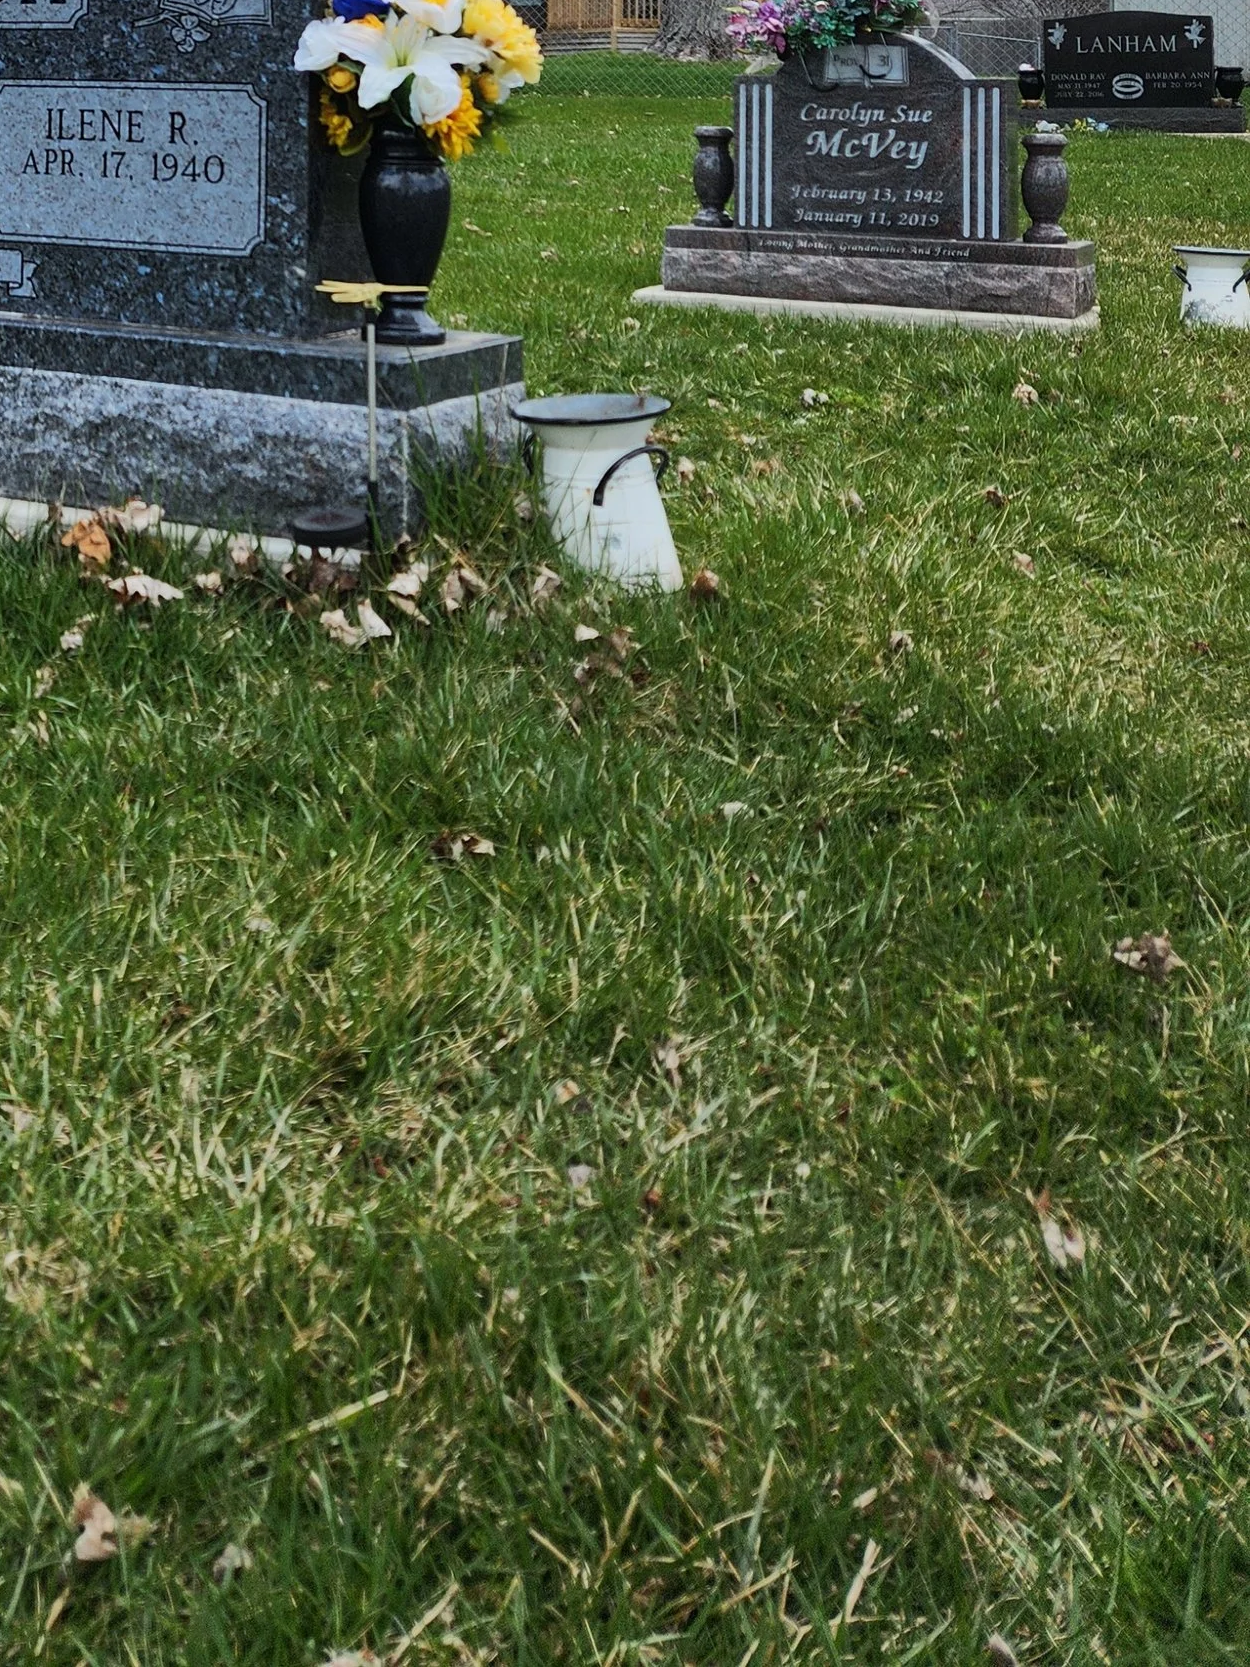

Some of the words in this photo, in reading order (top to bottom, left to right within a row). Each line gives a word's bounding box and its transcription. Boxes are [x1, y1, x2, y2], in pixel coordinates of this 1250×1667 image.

[1076, 34, 1178, 54] LANHAM
[1051, 73, 1087, 81] DONALD
[1090, 72, 1106, 80] RAY
[1145, 71, 1187, 80] BARBARA
[1190, 71, 1211, 79] ANN
[800, 102, 886, 127] Carolyn
[891, 105, 933, 123] Sue
[46, 108, 145, 143] ILENE
[169, 111, 199, 146] R.
[806, 128, 929, 170] McVey
[22, 149, 84, 177] APR.
[152, 153, 225, 184] 1940
[791, 186, 867, 204] February
[873, 188, 897, 203] 13,
[904, 189, 944, 204] 1942
[793, 208, 863, 228] January
[869, 212, 892, 227] 11,
[899, 213, 940, 227] 2019
[839, 243, 905, 254] Grandmother
[910, 245, 931, 256] And
[934, 246, 971, 258] Friend
